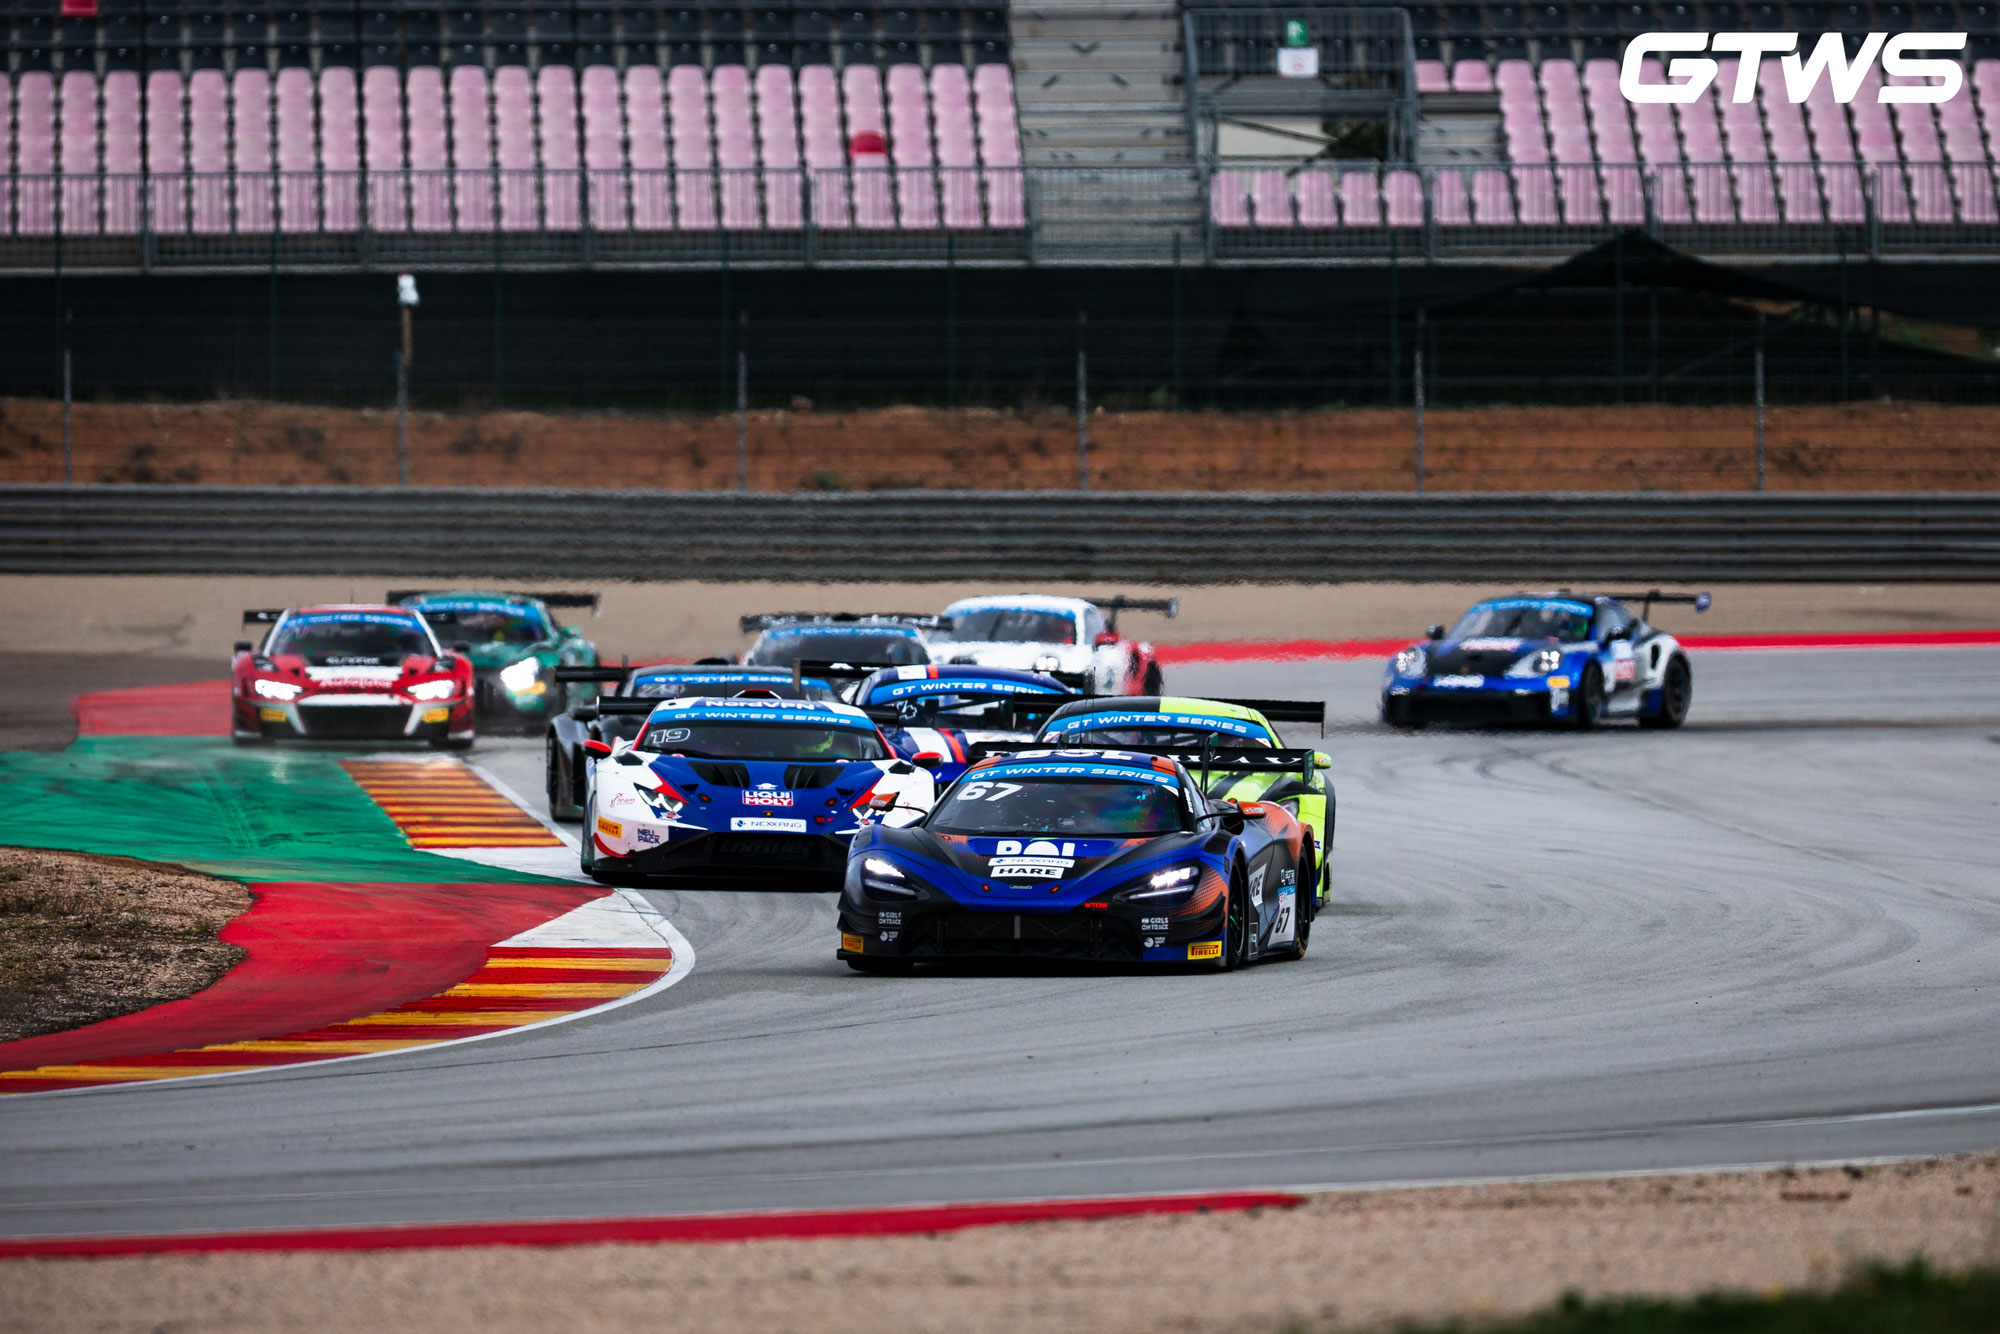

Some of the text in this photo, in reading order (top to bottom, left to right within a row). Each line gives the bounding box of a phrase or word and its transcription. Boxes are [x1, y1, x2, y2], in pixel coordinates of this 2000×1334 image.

[892, 685, 916, 696] GT
[920, 682, 987, 691] WINTER
[705, 700, 815, 710] NordVPN
[782, 714, 851, 724] SERIES
[1067, 714, 1247, 733] GT WINTER SERIES
[650, 727, 691, 744] 19
[971, 767, 1169, 783] GT WINTER SERIES
[744, 791, 790, 799] LIQUI
[955, 781, 1024, 802] 67
[744, 797, 791, 806] MOLY
[638, 836, 660, 844] PACK
[999, 868, 1058, 876] HARE
[1275, 906, 1290, 933] 67
[1191, 944, 1219, 956] PIRELLI
